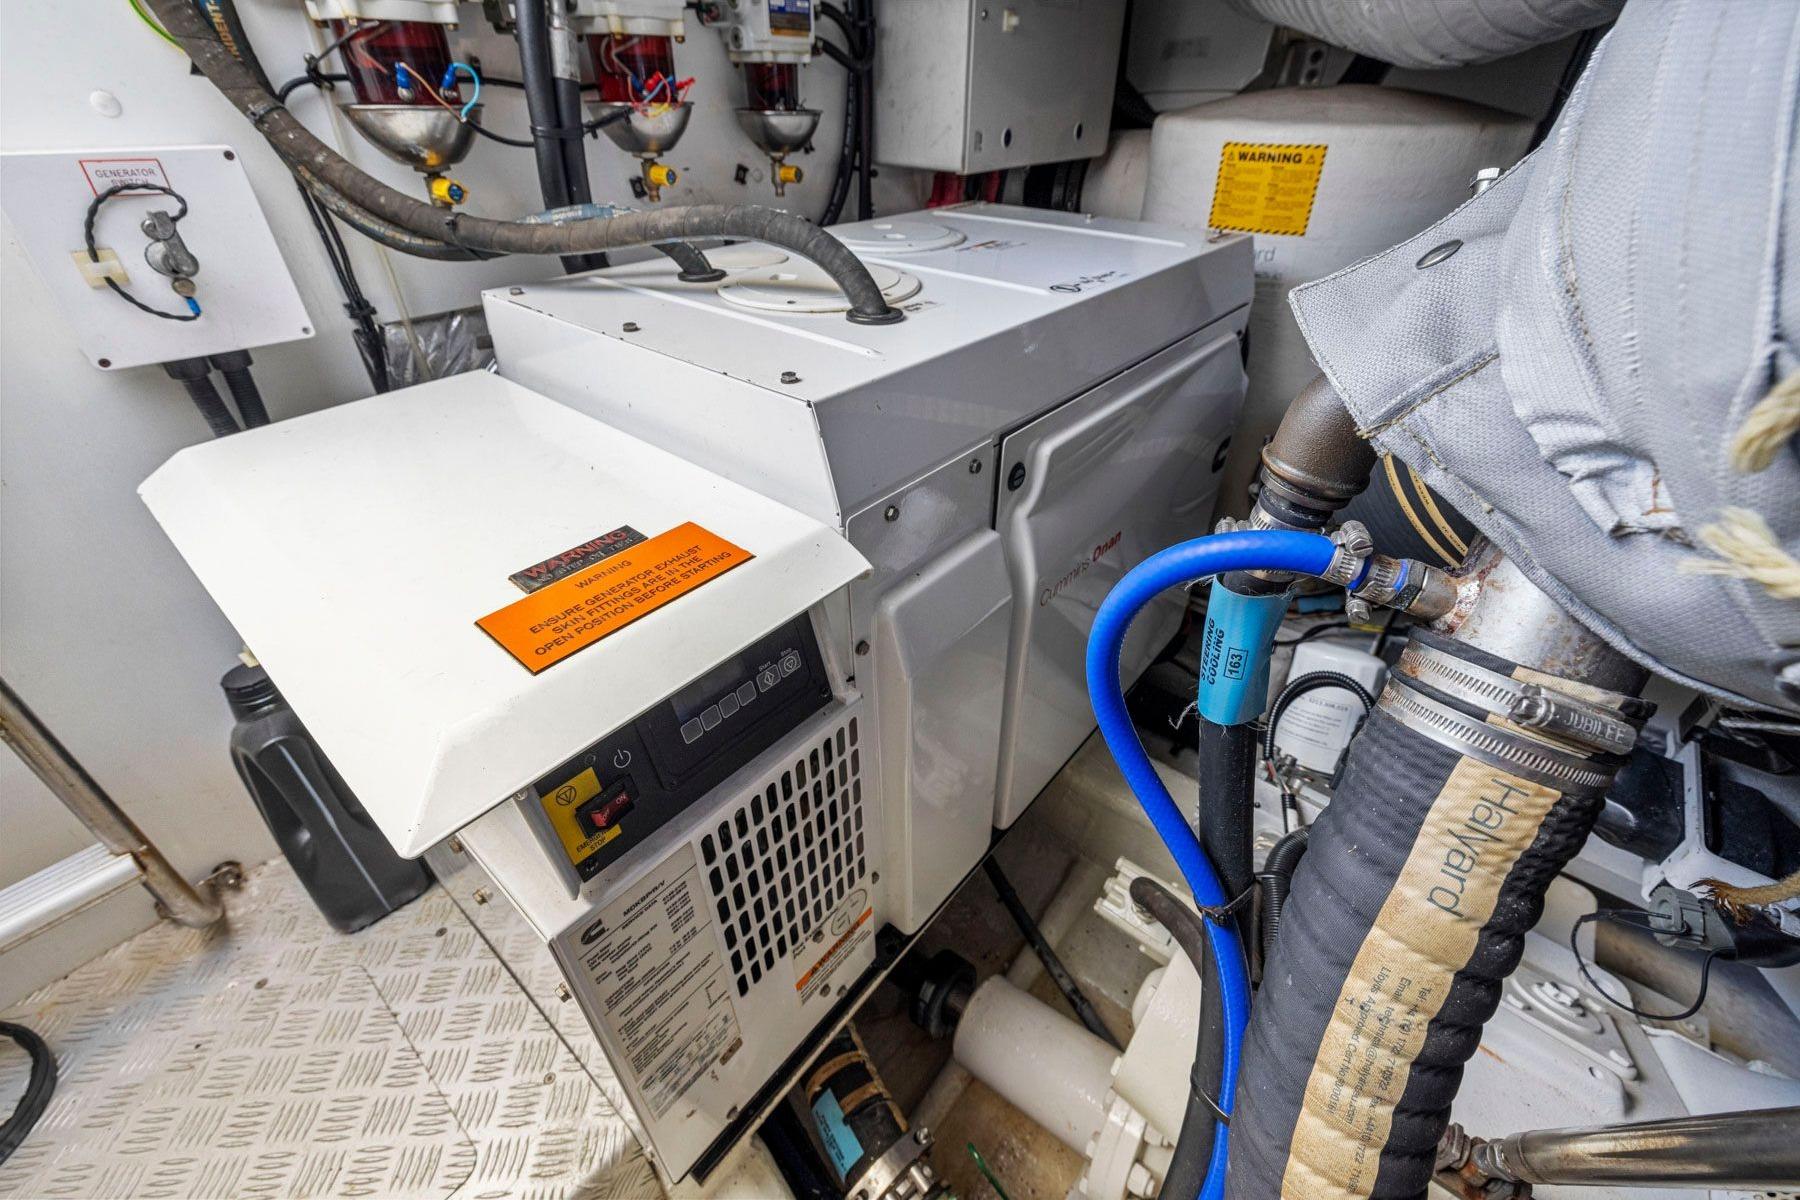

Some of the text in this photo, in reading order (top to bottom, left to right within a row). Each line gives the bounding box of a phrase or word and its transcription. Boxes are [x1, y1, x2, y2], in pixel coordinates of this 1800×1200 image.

[94, 167, 157, 178] GENERATOR
[1238, 151, 1303, 164] WARNING
[523, 530, 628, 578] WARNING
[575, 560, 632, 588] WARNING
[1041, 530, 1122, 607] Cummins Onan
[530, 544, 703, 635] ENSURE GENERATOR EXHAUST
[535, 551, 732, 657] OPEN POSITION BEFORE STARTING
[552, 555, 703, 635] SKIN FITTINGS ARE IN THE
[1201, 618, 1215, 681] STEERING
[1207, 628, 1225, 686] COOLING
[1228, 653, 1243, 676] 163
[1564, 712, 1625, 744] JUBILEE
[1427, 778, 1529, 919] Halyard
[1370, 966, 1391, 994] Lloyds
[1350, 996, 1375, 1042] Approved
[1342, 1043, 1357, 1063] Cert
